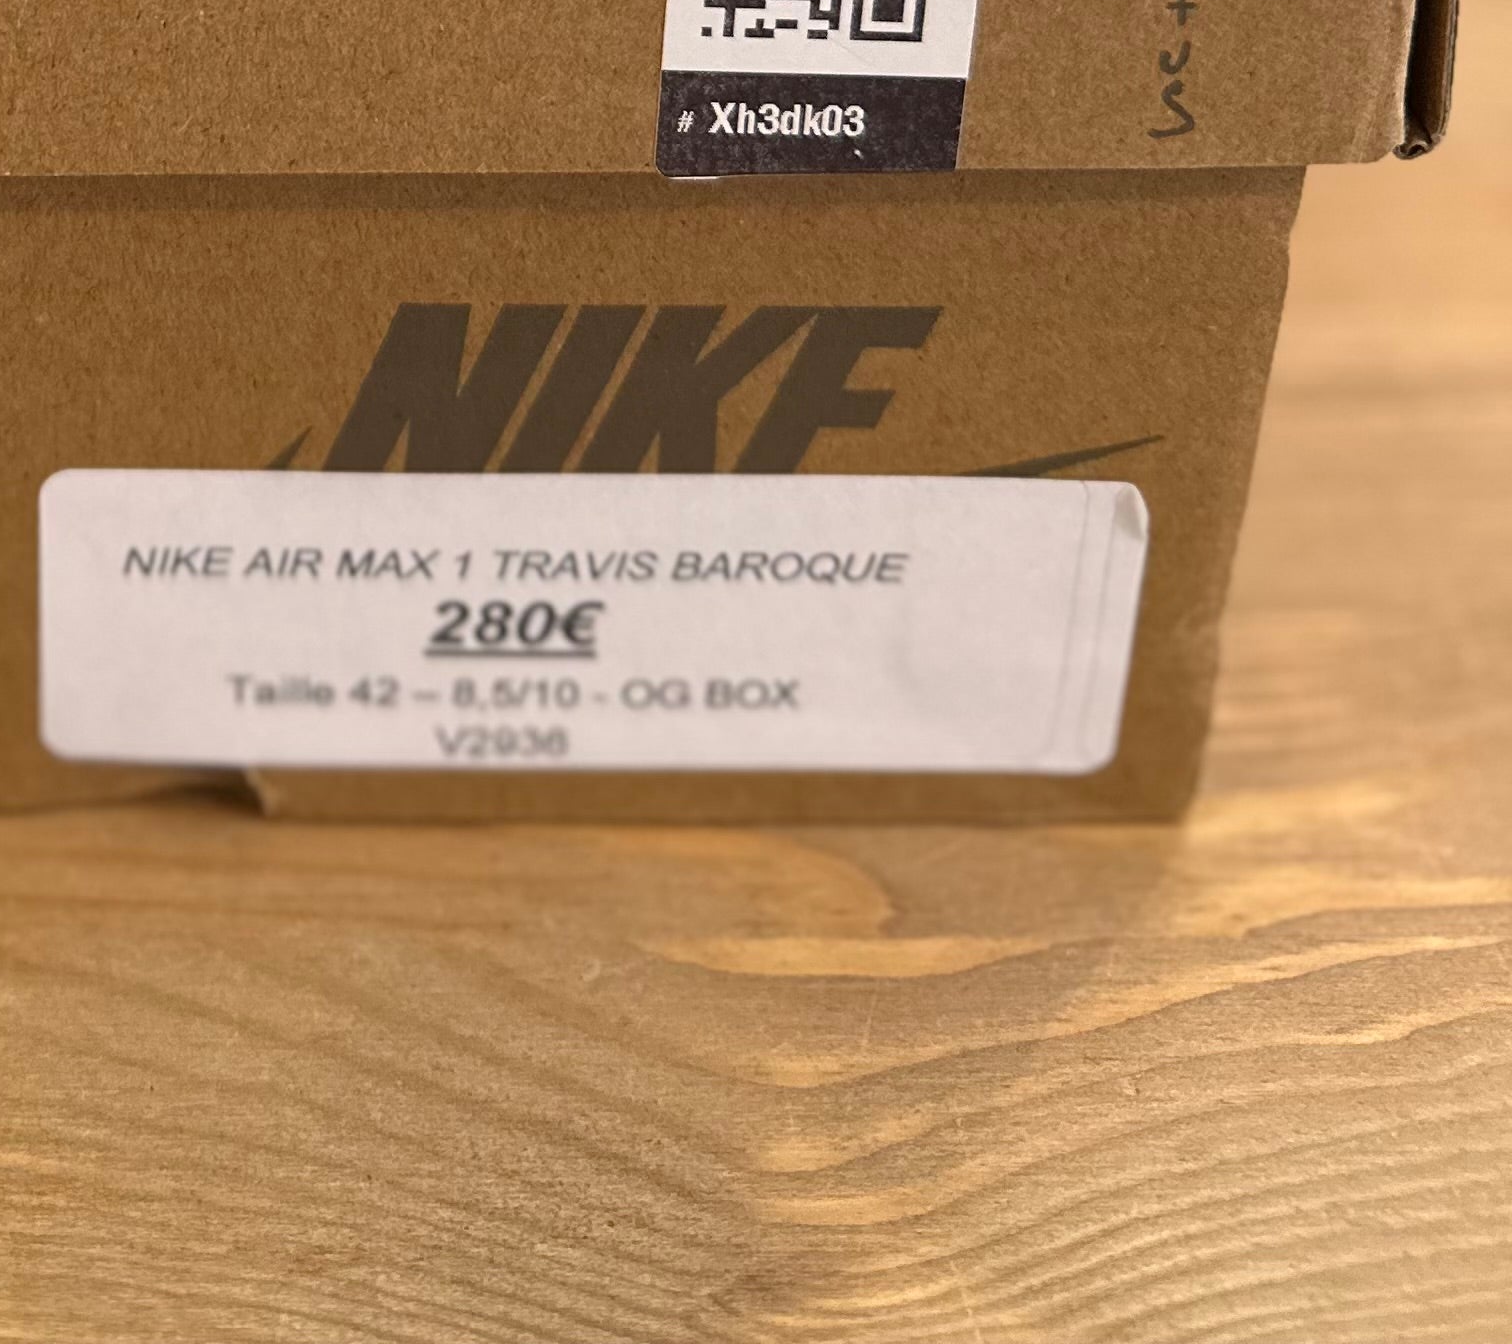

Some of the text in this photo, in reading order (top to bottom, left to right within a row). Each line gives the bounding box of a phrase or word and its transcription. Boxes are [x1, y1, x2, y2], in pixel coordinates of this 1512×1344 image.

[708, 101, 865, 137] Xh3dk03
[322, 302, 944, 474] NIKE
[122, 545, 910, 584] NIKE AIR MAX 1 TRAVIS BAROQUE
[428, 599, 606, 650] 280€
[226, 673, 336, 708] Taille
[347, 675, 400, 709] 42
[620, 677, 692, 712] OG
[703, 678, 801, 711] BOX
